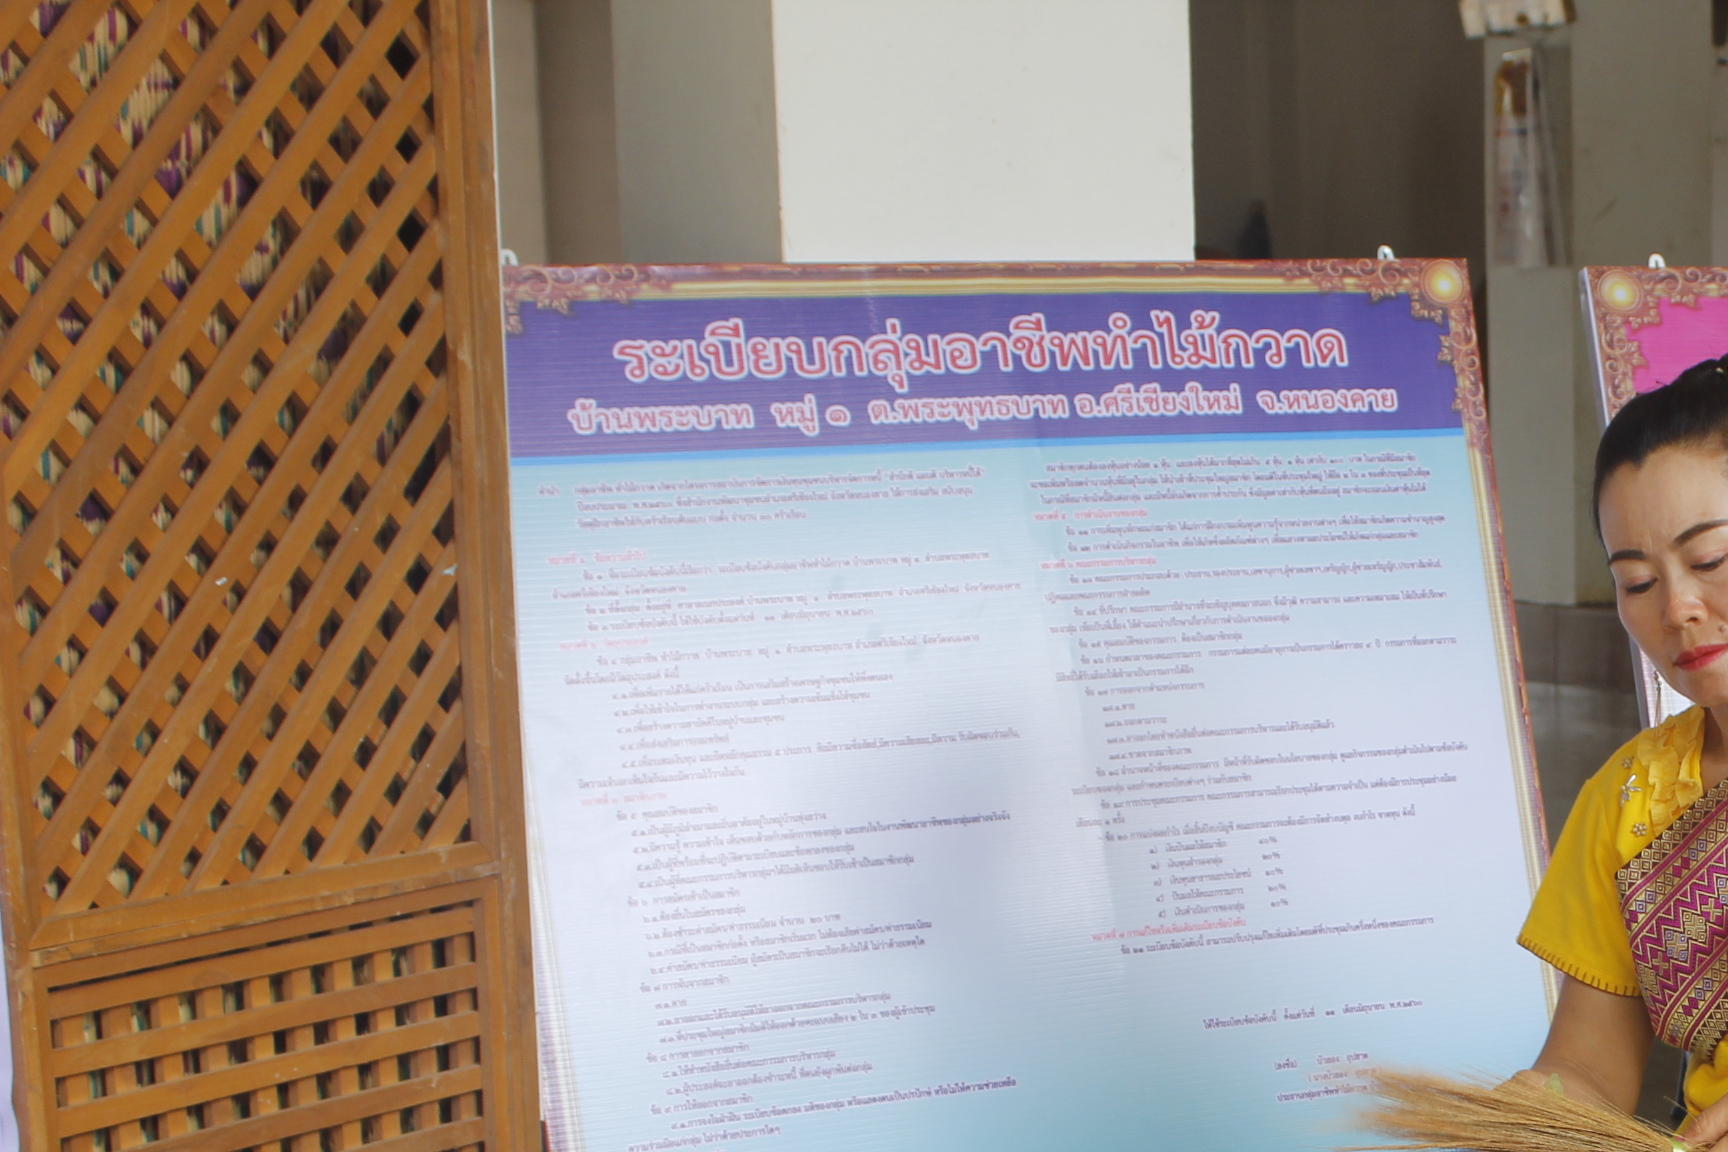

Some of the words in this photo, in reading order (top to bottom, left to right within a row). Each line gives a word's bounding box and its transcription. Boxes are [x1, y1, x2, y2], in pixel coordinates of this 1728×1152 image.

[613, 311, 1348, 392] ระเบียบกลุ่มอาชีพทำไม้กวาด
[567, 398, 755, 435] บ้านพระบาท
[770, 393, 818, 436] หมู่
[825, 405, 850, 427] ๑
[868, 391, 1067, 430] ต.พระพุทธบาท
[1075, 380, 1243, 418] อ.ศรีเชียงใหม่
[1257, 386, 1398, 416] จ.หนองคาย
